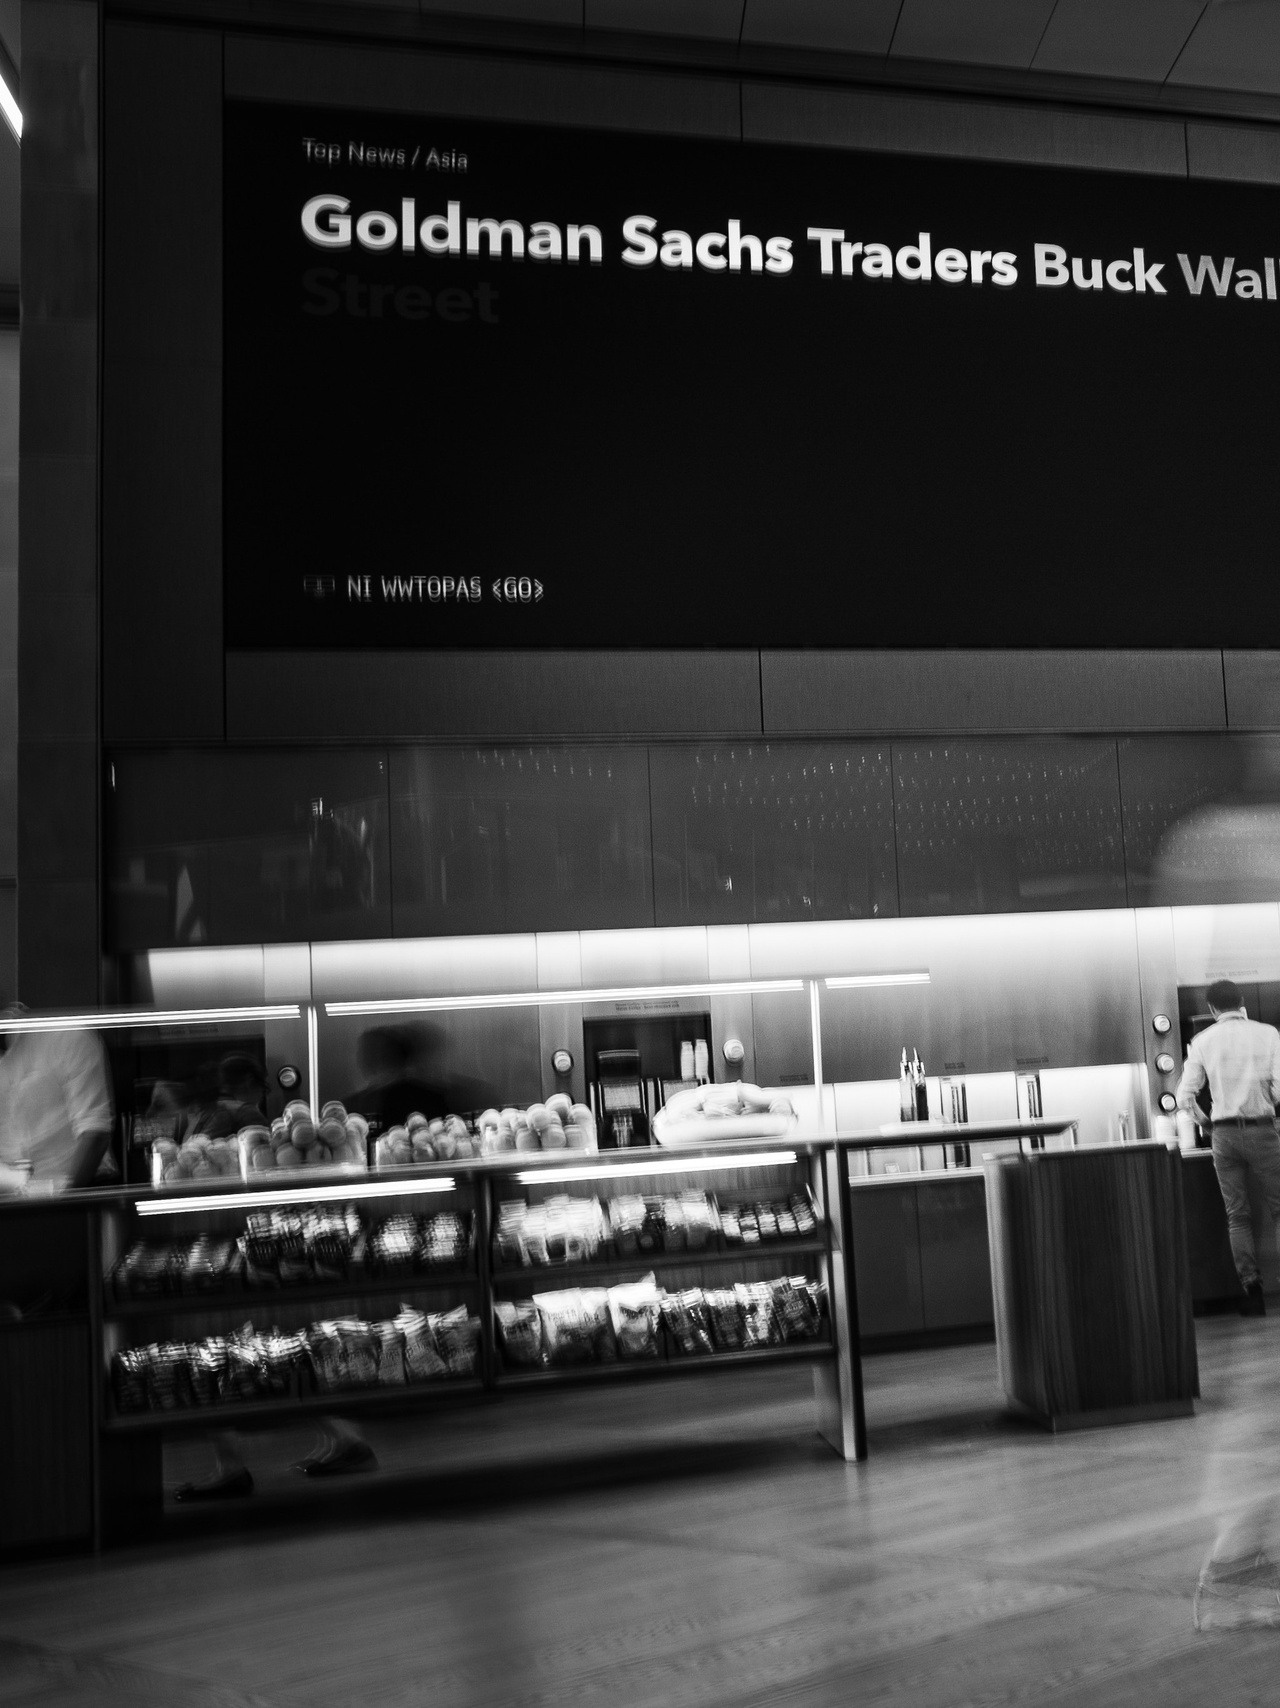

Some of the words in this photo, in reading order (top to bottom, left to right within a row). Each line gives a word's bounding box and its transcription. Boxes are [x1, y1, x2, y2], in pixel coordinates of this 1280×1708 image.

[302, 137, 341, 168] Top
[349, 140, 406, 168] News
[425, 147, 468, 172] Asia
[300, 193, 604, 265] Goldman
[621, 214, 795, 277] Sachs
[806, 226, 1019, 288] Traders
[1033, 242, 1168, 296] Buck
[301, 266, 501, 323] Street
[347, 575, 372, 602] NI
